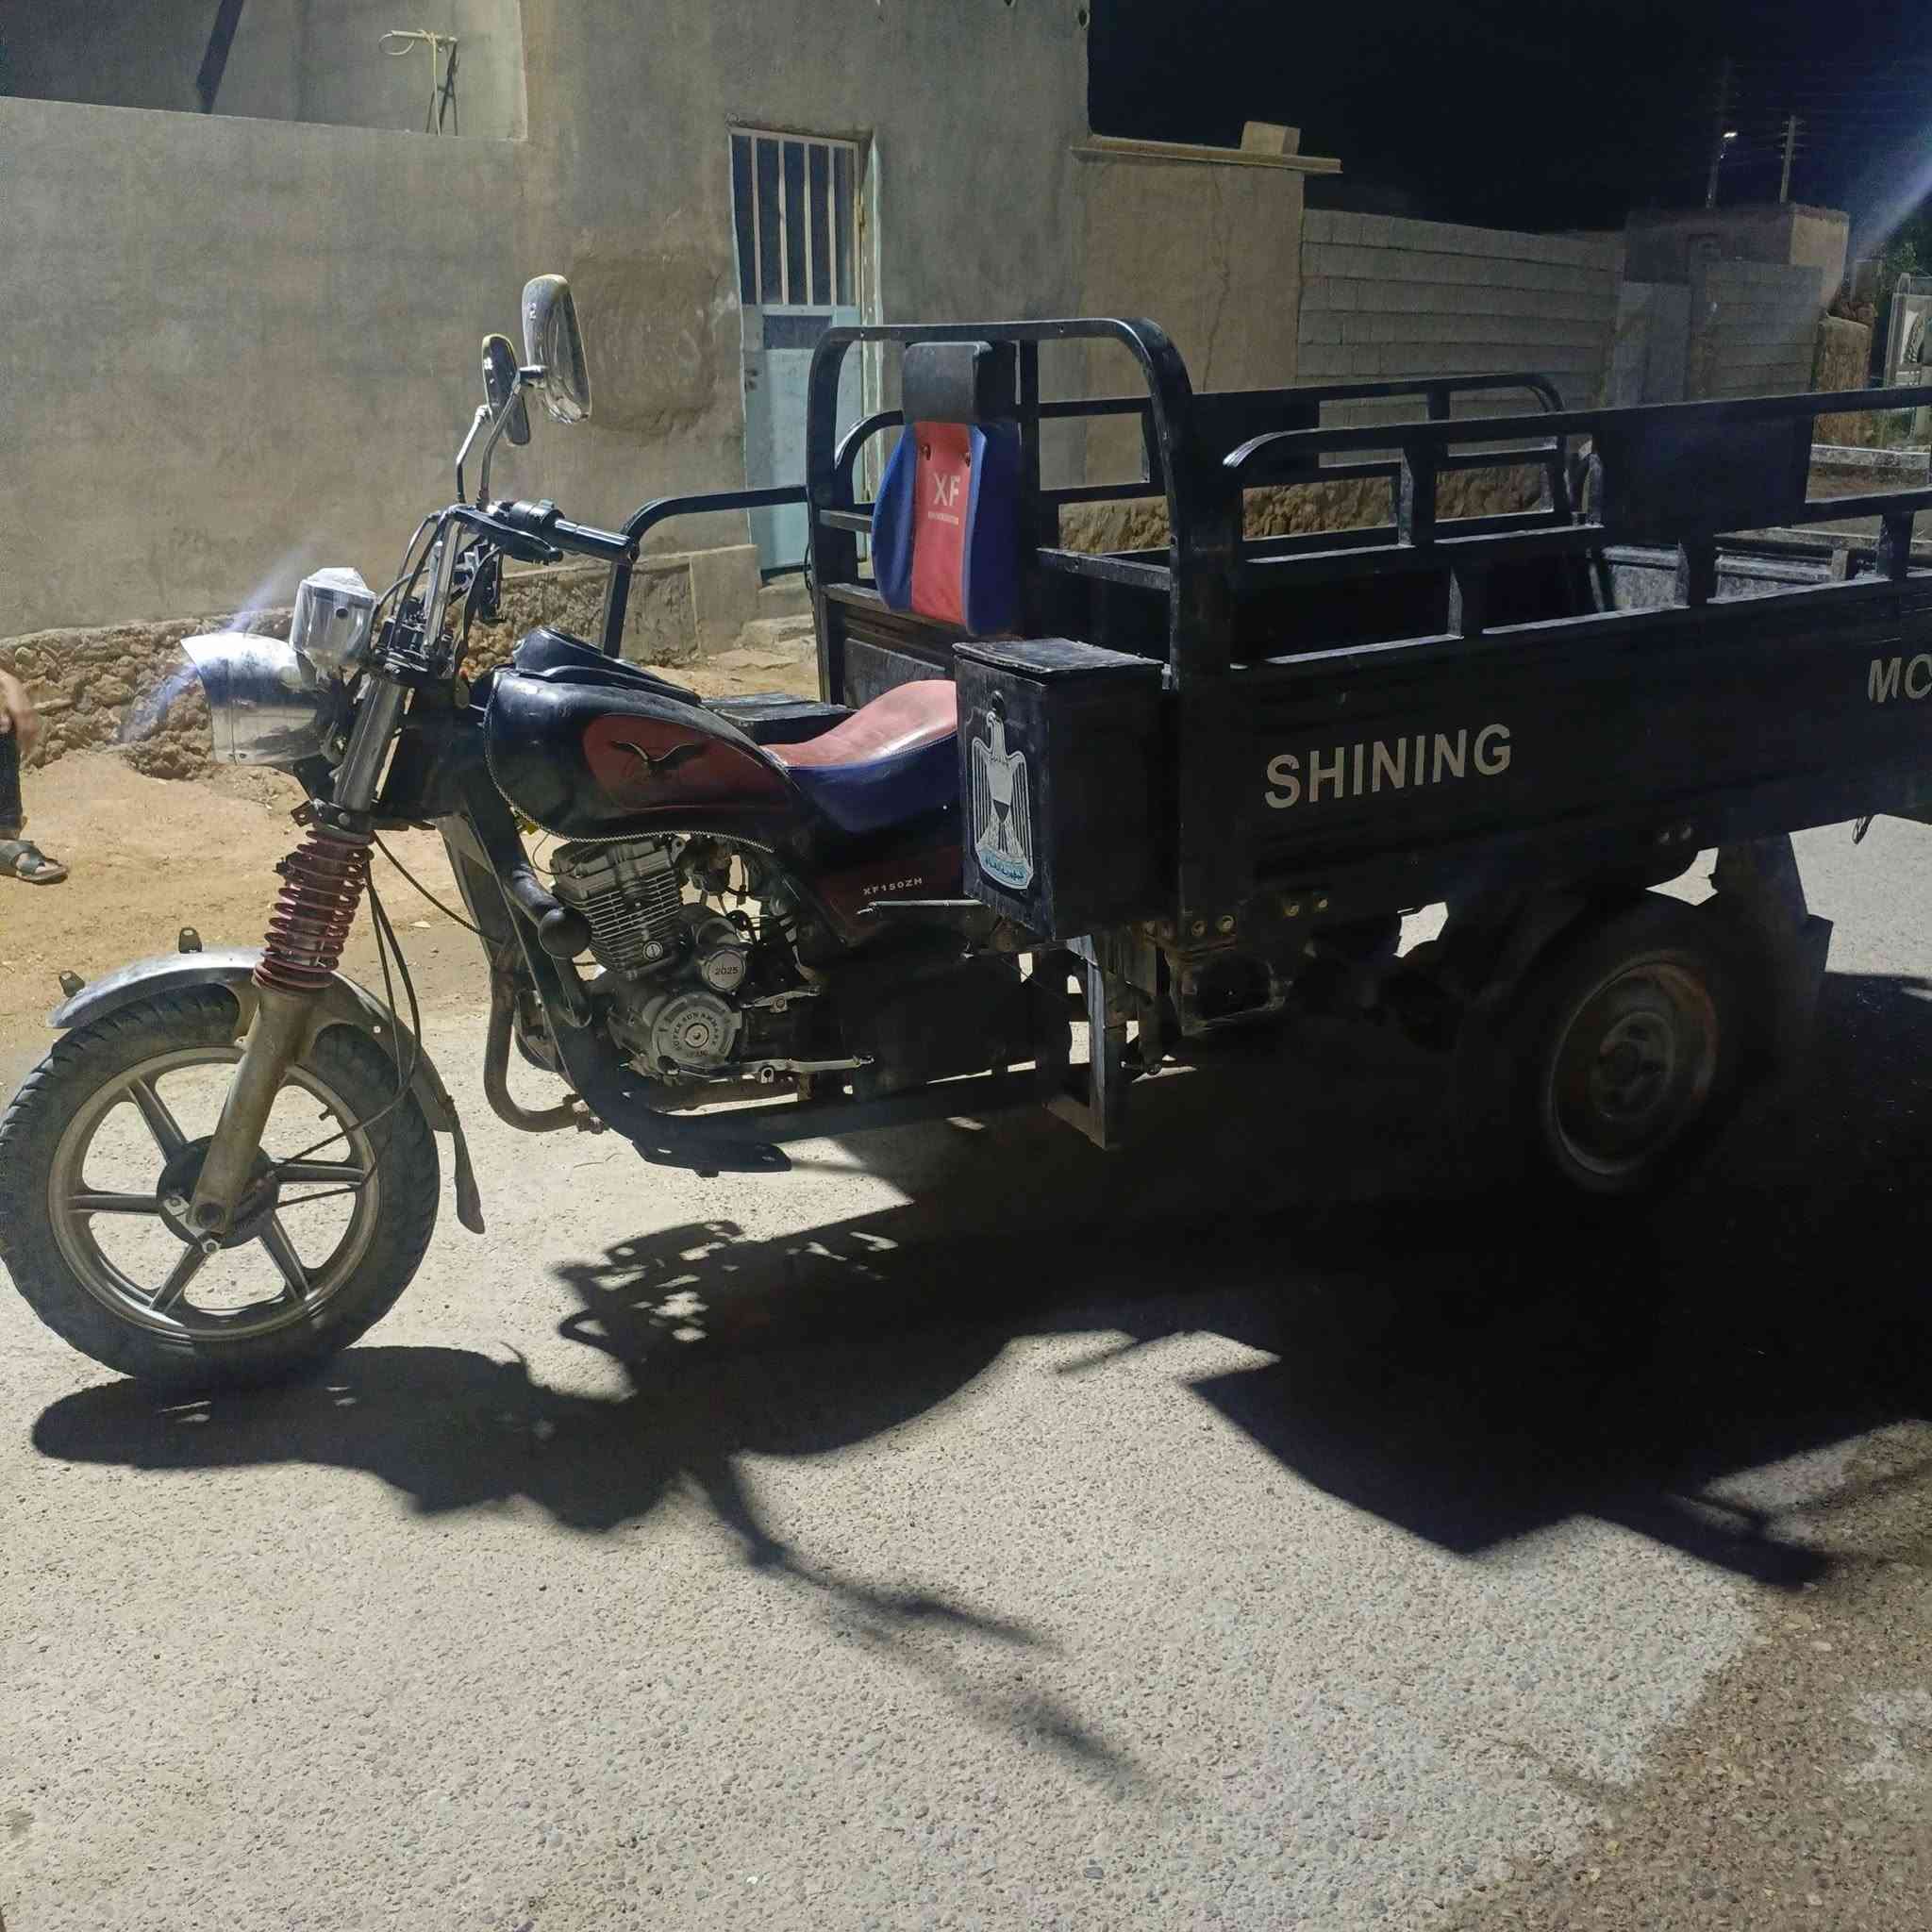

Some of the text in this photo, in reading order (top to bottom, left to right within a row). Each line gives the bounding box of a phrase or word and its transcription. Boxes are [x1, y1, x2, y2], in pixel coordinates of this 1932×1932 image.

[934, 472, 960, 507] XF
[1264, 723, 1511, 808] SHINING
[863, 877, 923, 895] XF150ZH
[714, 966, 741, 975] 2025
